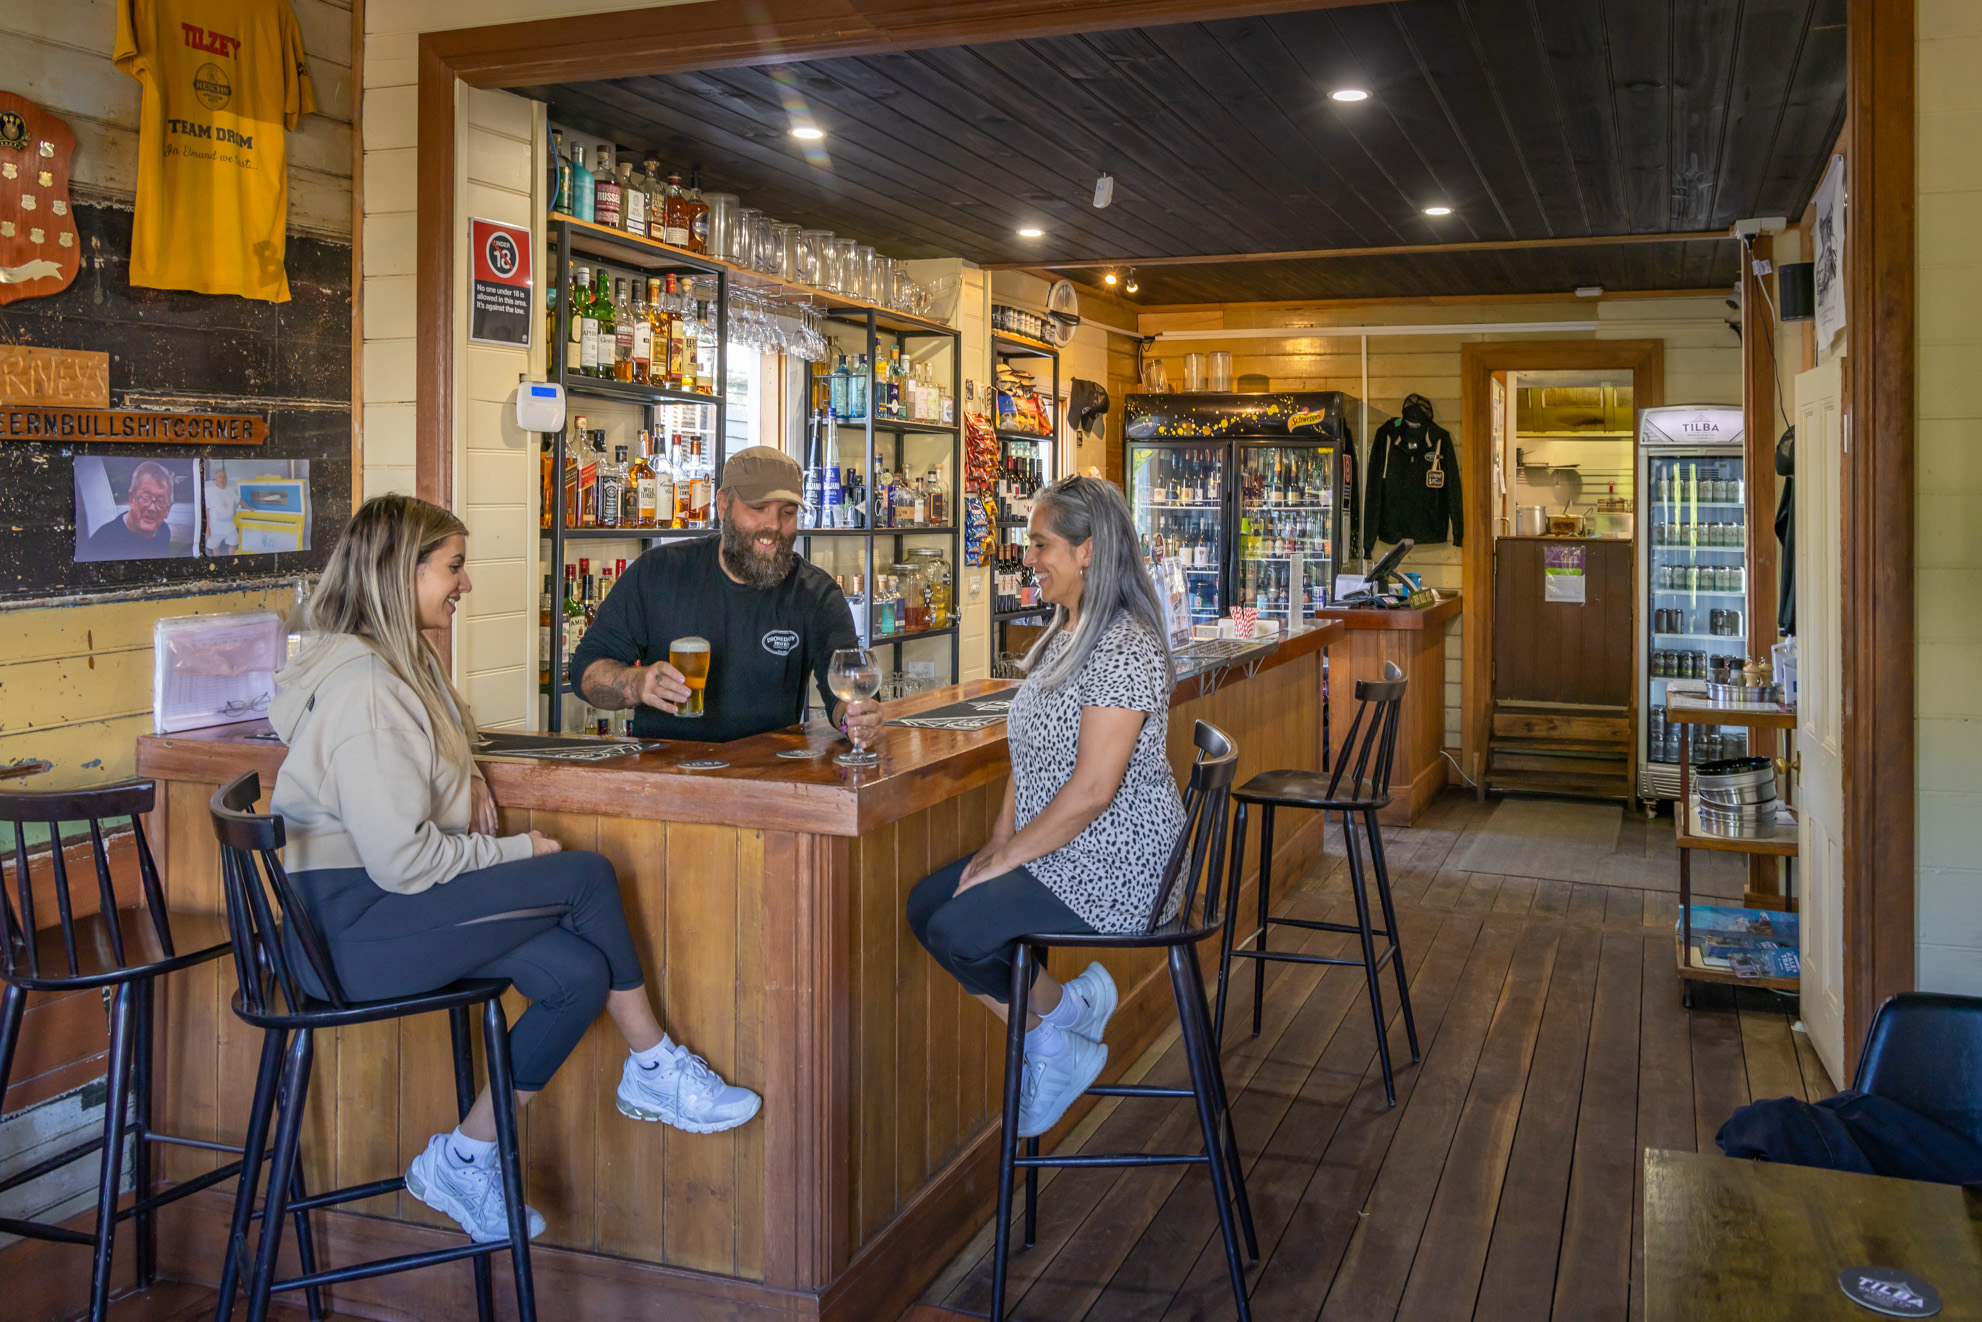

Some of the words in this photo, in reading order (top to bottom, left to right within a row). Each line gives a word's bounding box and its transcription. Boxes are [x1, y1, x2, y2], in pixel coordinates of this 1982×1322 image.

[181, 22, 241, 61] TILZEY
[196, 80, 229, 95] RESCHS
[168, 119, 212, 139] TEAM
[163, 143, 180, 158] In
[219, 154, 233, 163] we
[493, 249, 512, 270] 18
[477, 293, 497, 302] allowed
[497, 288, 512, 296] under
[485, 303, 505, 312] against
[506, 305, 514, 313] the
[515, 306, 525, 315] law.
[1292, 414, 1321, 426] Schweppes
[1683, 423, 1720, 432] TILBA
[1859, 1276, 1924, 1309] TILBA
